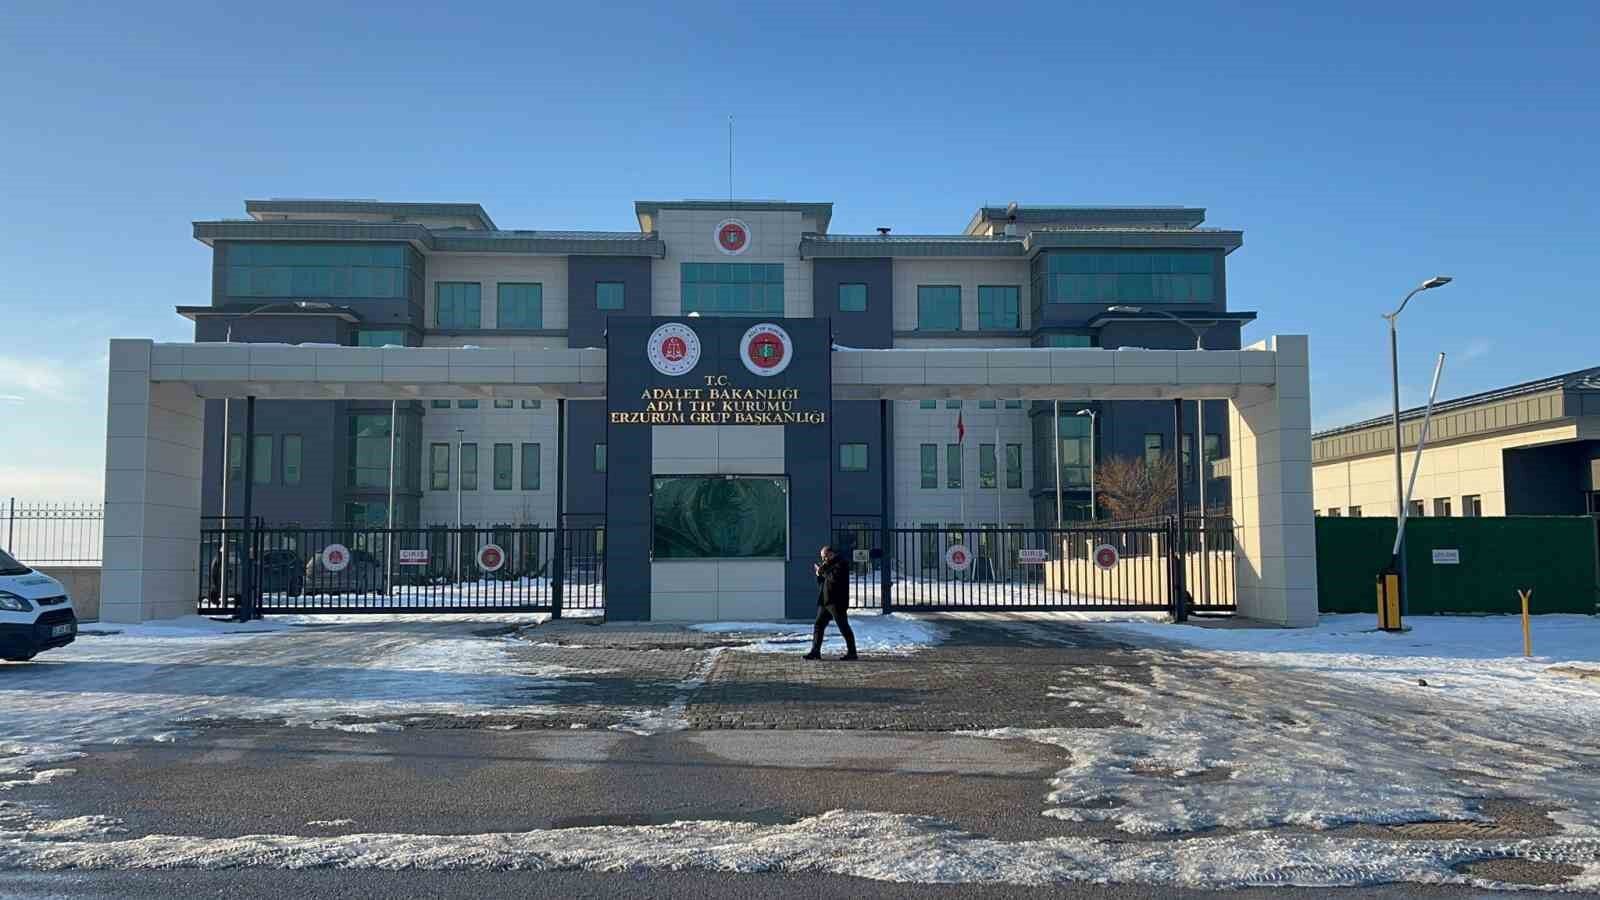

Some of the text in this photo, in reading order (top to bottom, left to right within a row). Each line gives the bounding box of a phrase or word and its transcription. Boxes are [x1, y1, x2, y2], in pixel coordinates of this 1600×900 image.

[641, 388, 703, 399] ADALET
[690, 401, 715, 411] TIP
[723, 401, 792, 412] KURUMU
[611, 412, 684, 423] ERZURUM
[690, 412, 730, 423] GRUP
